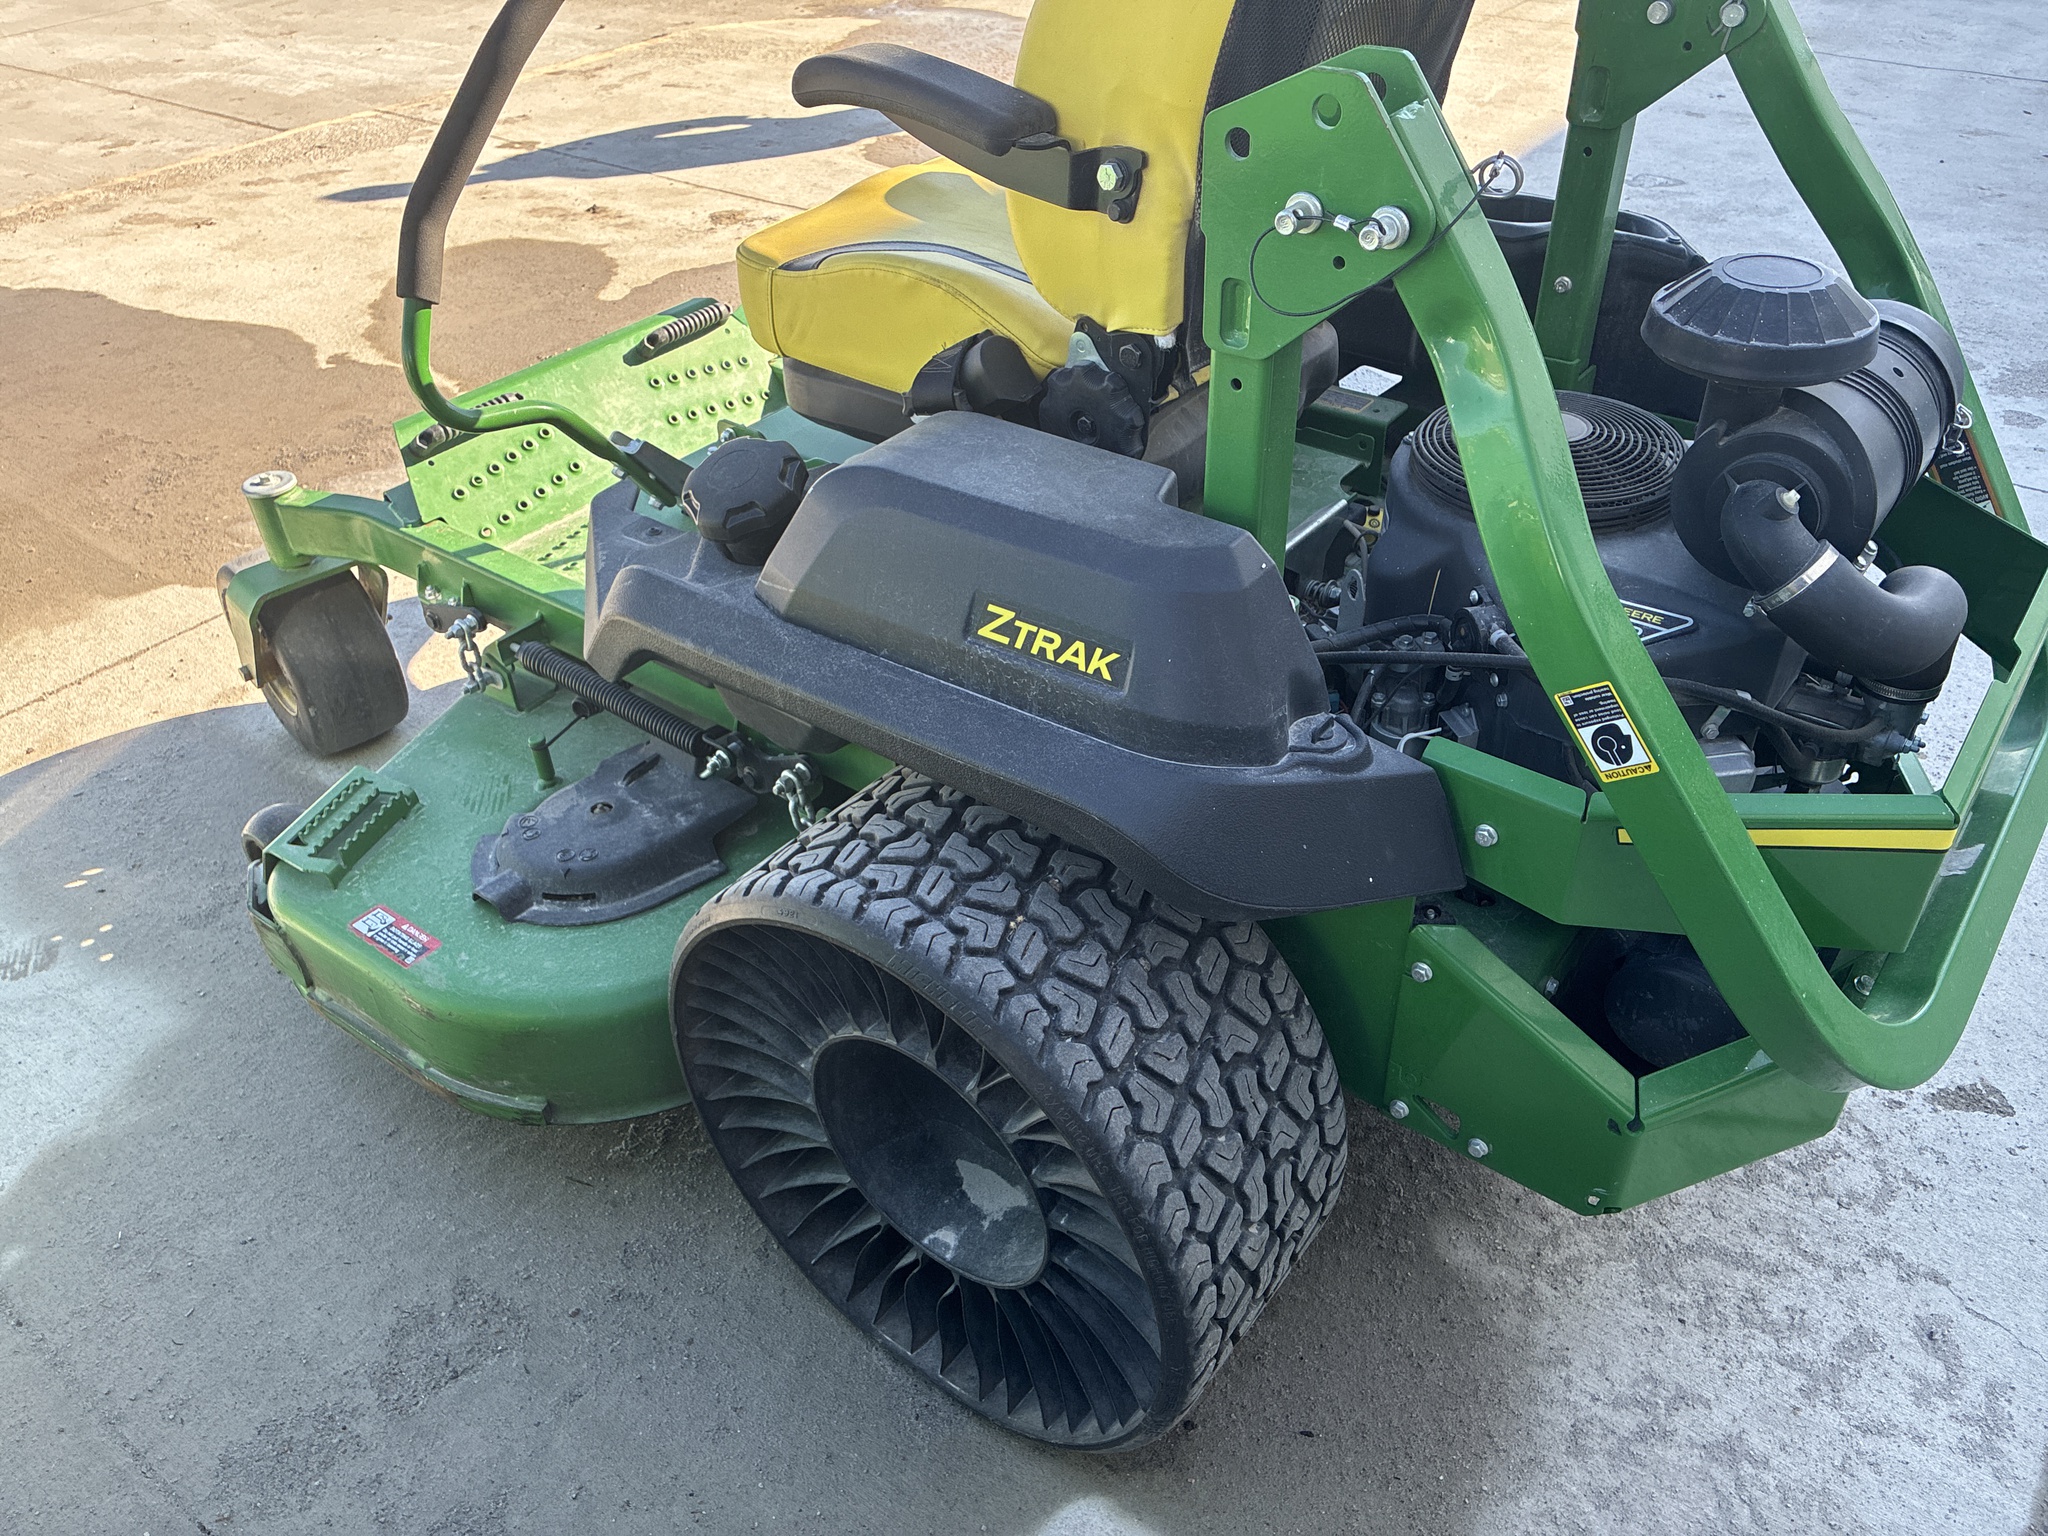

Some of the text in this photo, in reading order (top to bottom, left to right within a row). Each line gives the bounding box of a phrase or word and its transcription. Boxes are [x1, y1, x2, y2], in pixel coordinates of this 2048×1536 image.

[1623, 607, 1665, 625] EERE
[977, 603, 1121, 681] ZTRAK
[1604, 765, 1645, 780] CAUTION
